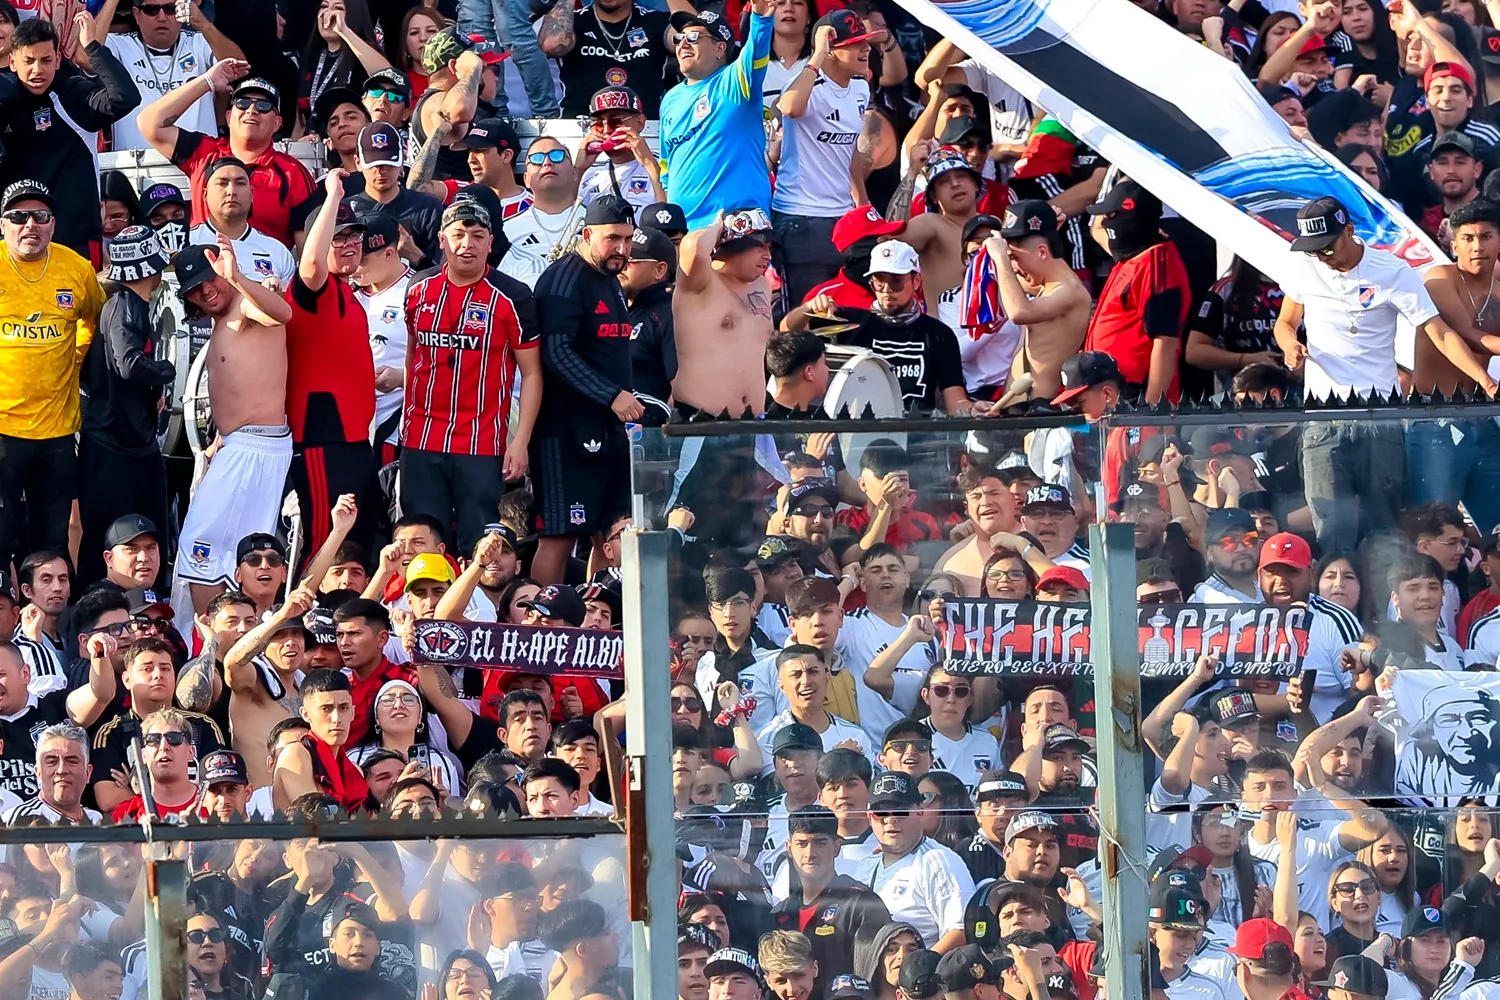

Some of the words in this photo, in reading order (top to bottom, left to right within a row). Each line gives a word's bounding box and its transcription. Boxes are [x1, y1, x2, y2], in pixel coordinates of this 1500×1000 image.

[831, 133, 856, 144] JUGA
[2, 179, 50, 205] UIKSILV
[2, 321, 63, 341] CRISTAL
[192, 326, 212, 336] SANG
[418, 331, 479, 350] DIRECTV
[896, 365, 920, 378] 1968
[1126, 483, 1144, 496] GB
[944, 602, 1018, 665] THE
[468, 627, 496, 661] EL
[1048, 975, 1064, 990] NY
